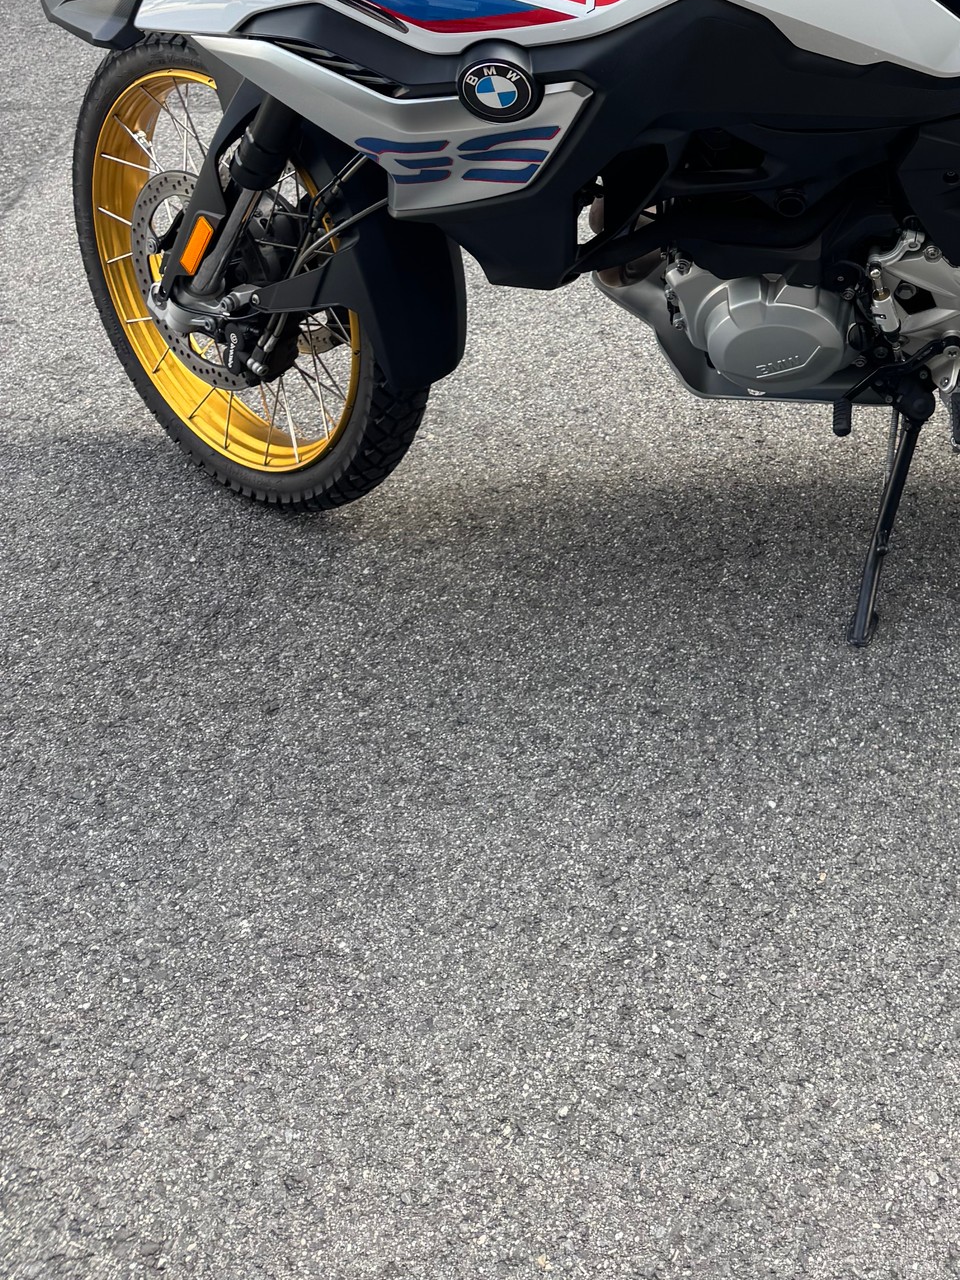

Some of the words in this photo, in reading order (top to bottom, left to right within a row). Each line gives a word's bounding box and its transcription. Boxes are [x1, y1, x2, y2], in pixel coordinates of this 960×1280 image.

[466, 66, 520, 86] BMW
[354, 125, 561, 185] GS
[755, 355, 799, 374] BMW
